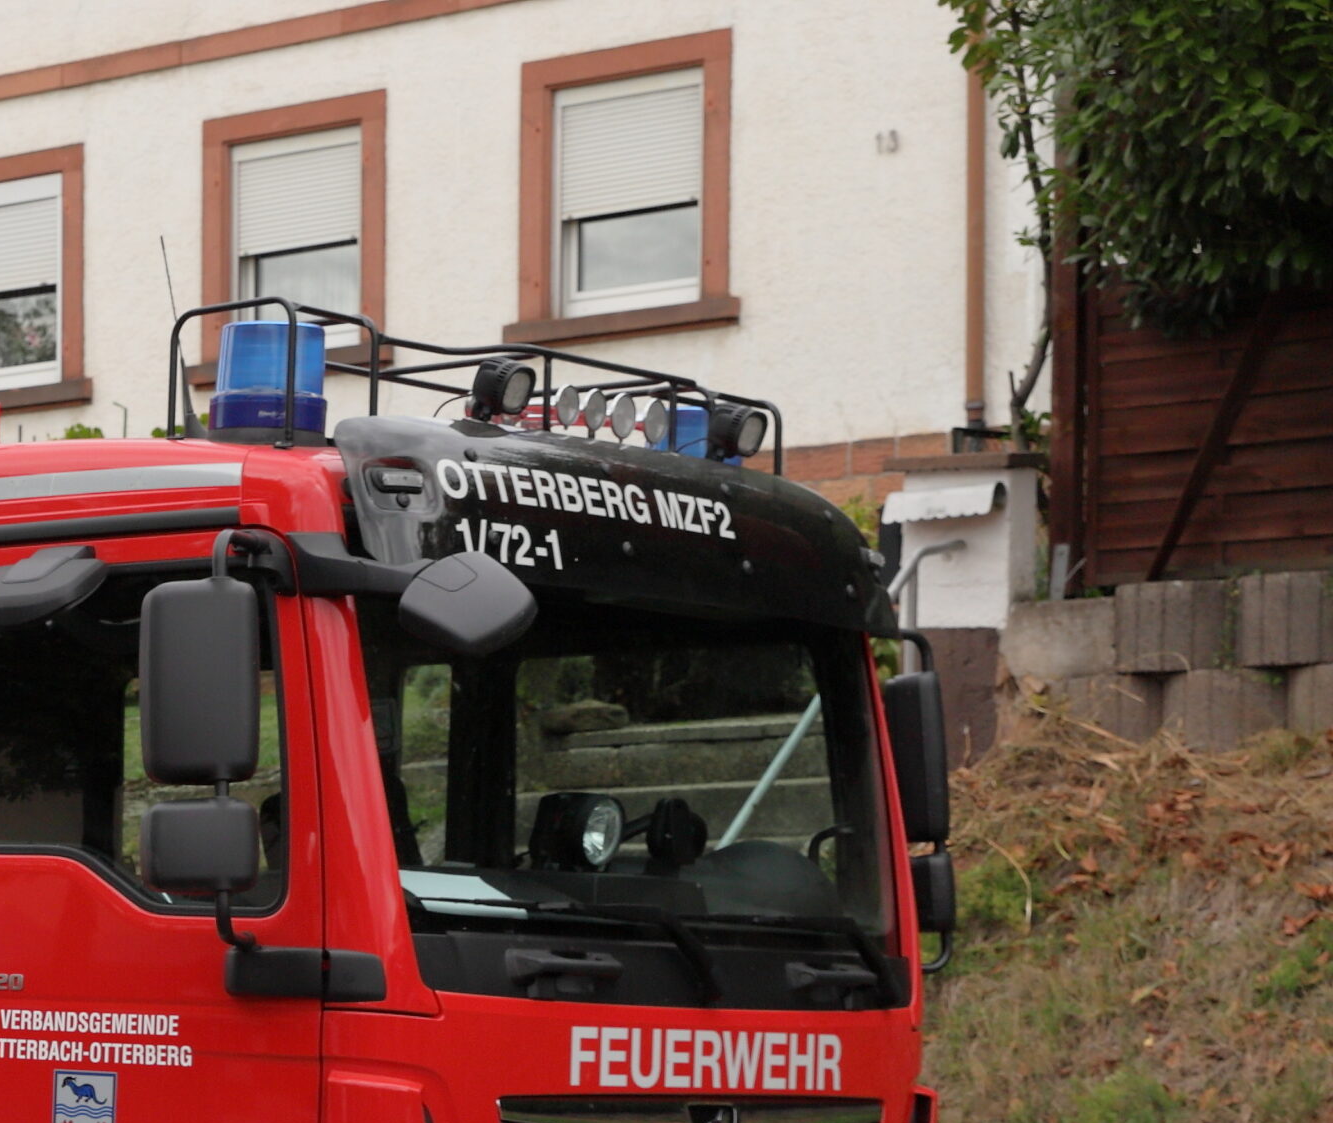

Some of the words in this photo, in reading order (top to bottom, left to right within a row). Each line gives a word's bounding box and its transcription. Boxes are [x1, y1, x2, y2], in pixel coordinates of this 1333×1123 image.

[436, 458, 652, 525] OTTERBERG
[652, 489, 737, 540] MZF2
[454, 517, 564, 571] 1/72-1
[0, 1008, 180, 1037] VERBANDSGEMEINDE
[569, 1025, 843, 1092] FEUERWEHR
